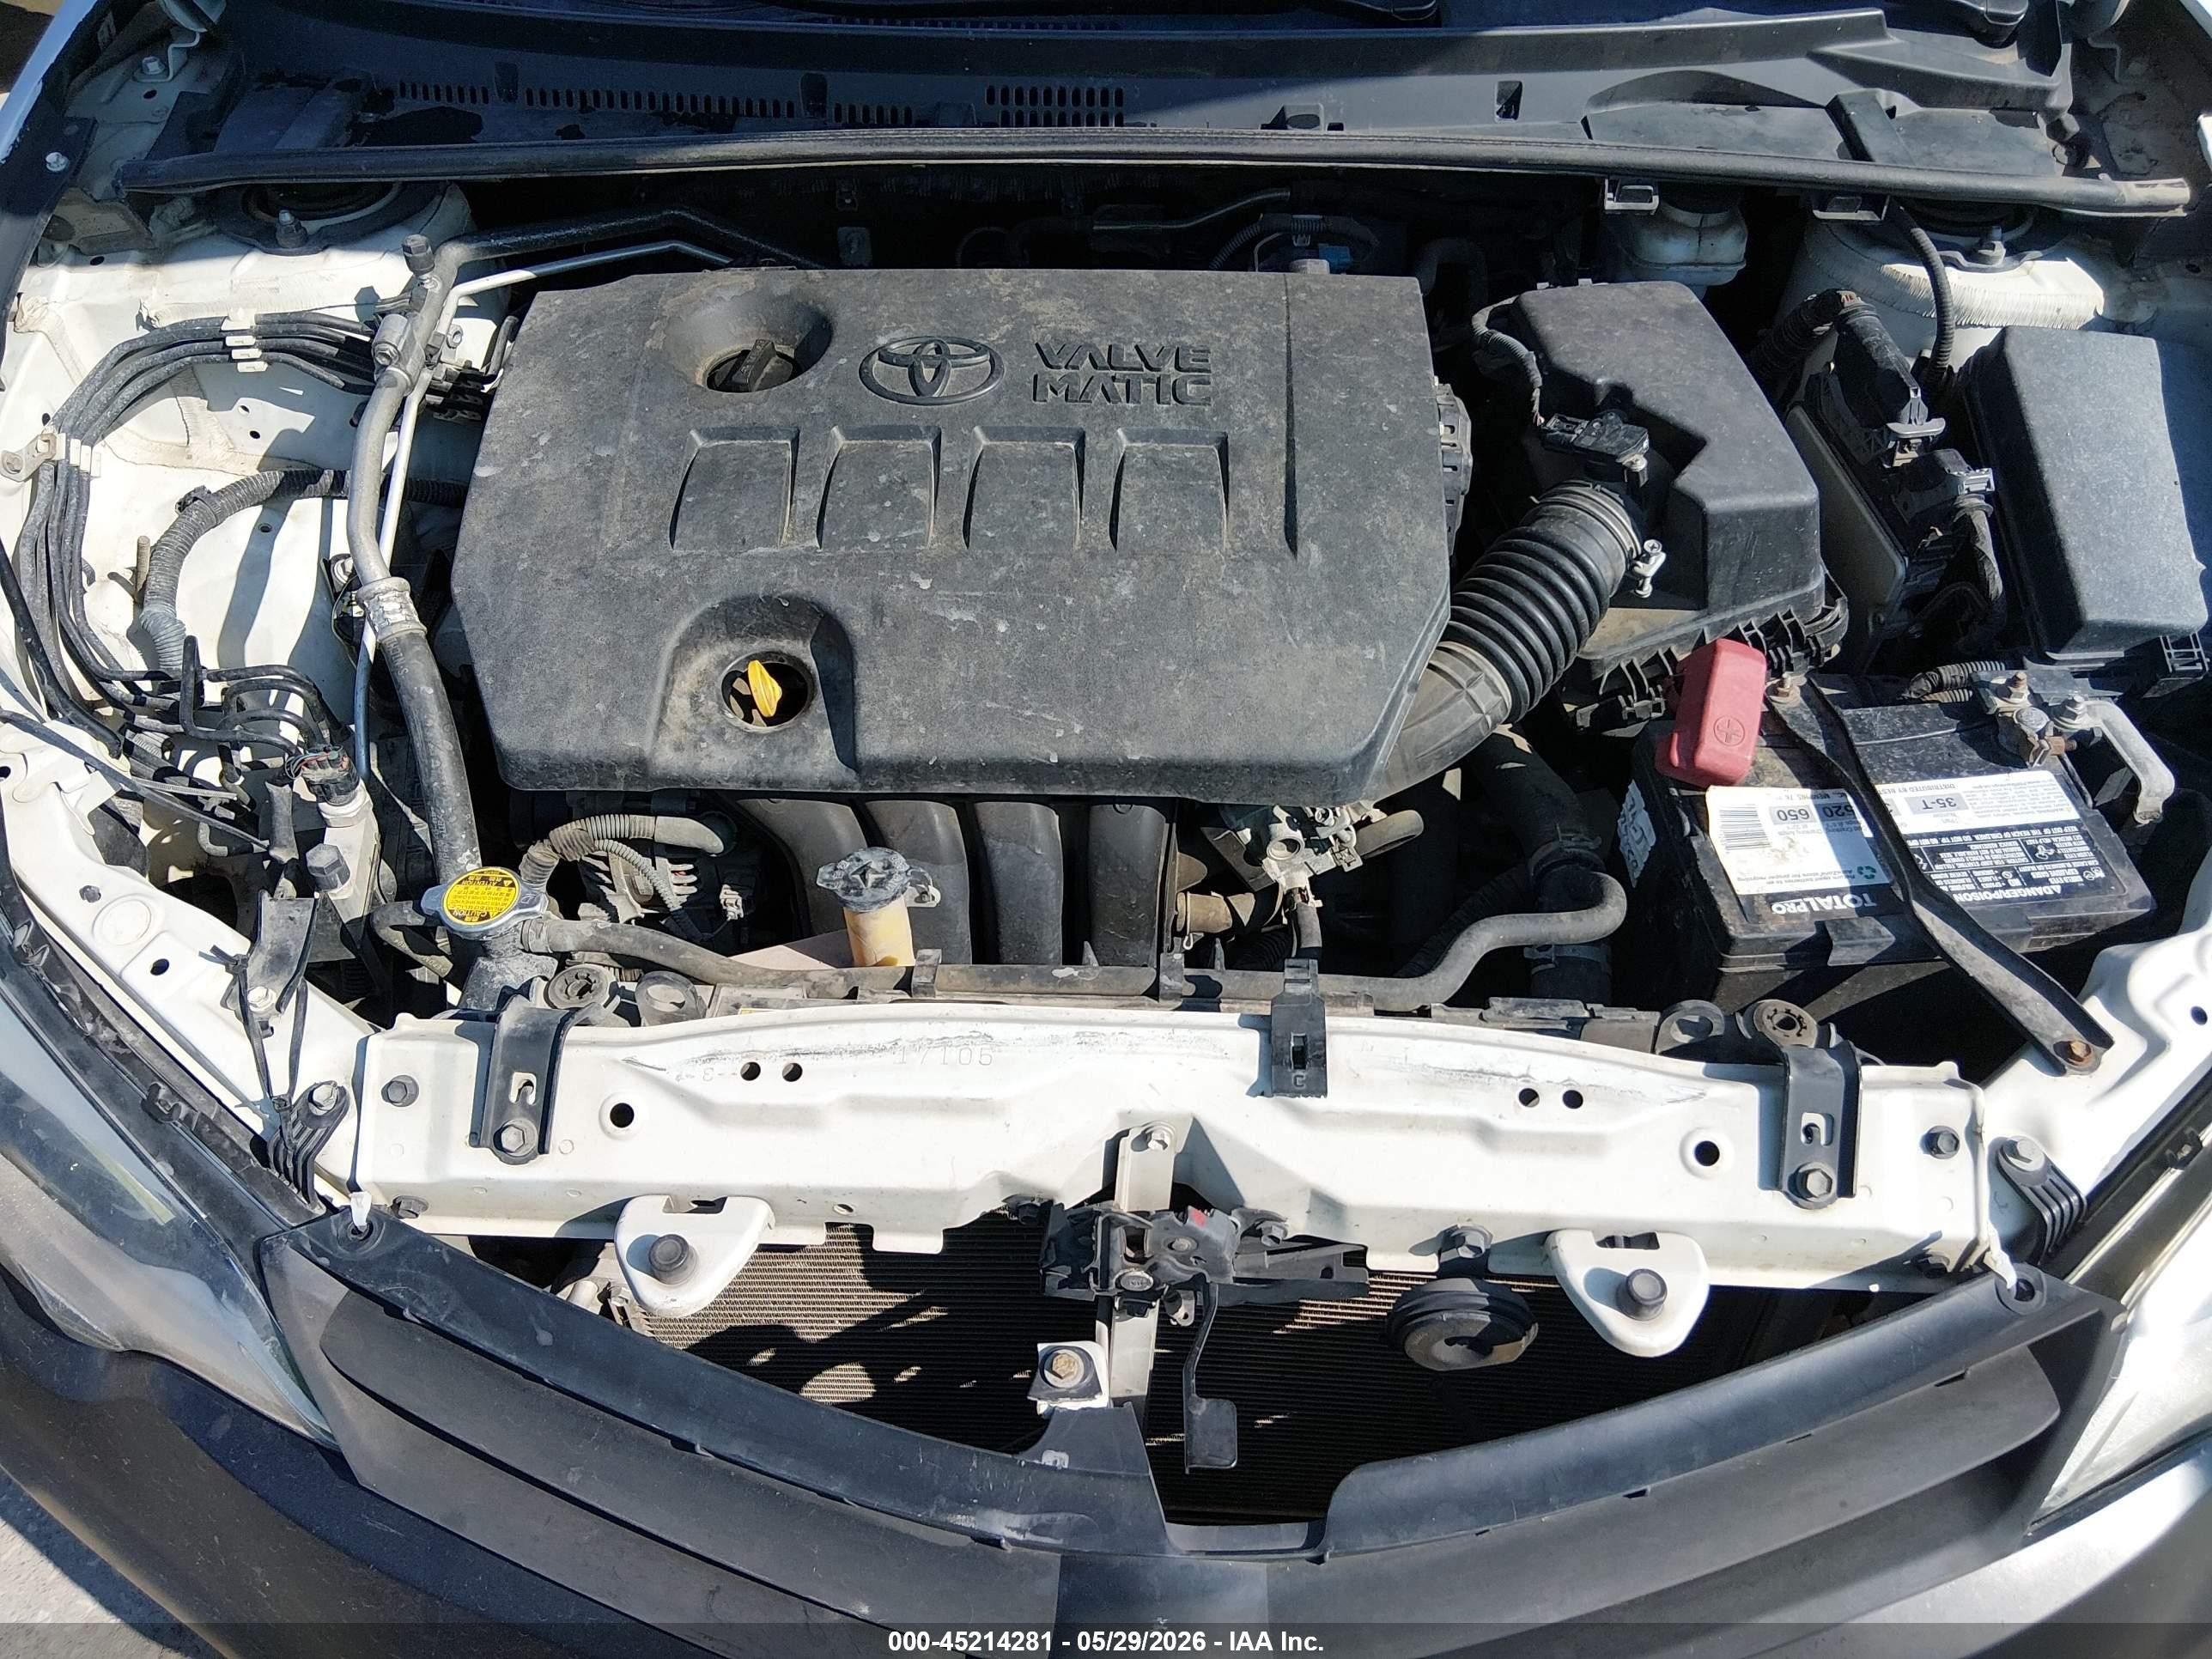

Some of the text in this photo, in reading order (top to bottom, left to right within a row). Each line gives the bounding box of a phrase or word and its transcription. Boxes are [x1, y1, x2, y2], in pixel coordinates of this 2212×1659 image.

[1036, 343, 1212, 373] VALVE
[1032, 373, 1212, 405] MATIC
[1822, 804, 1856, 818] 520
[1922, 796, 1957, 811] 35-T
[1777, 808, 1810, 822] 650
[1954, 885, 2053, 901] DANGER/POISON
[1771, 893, 1877, 915] TOTALPRO
